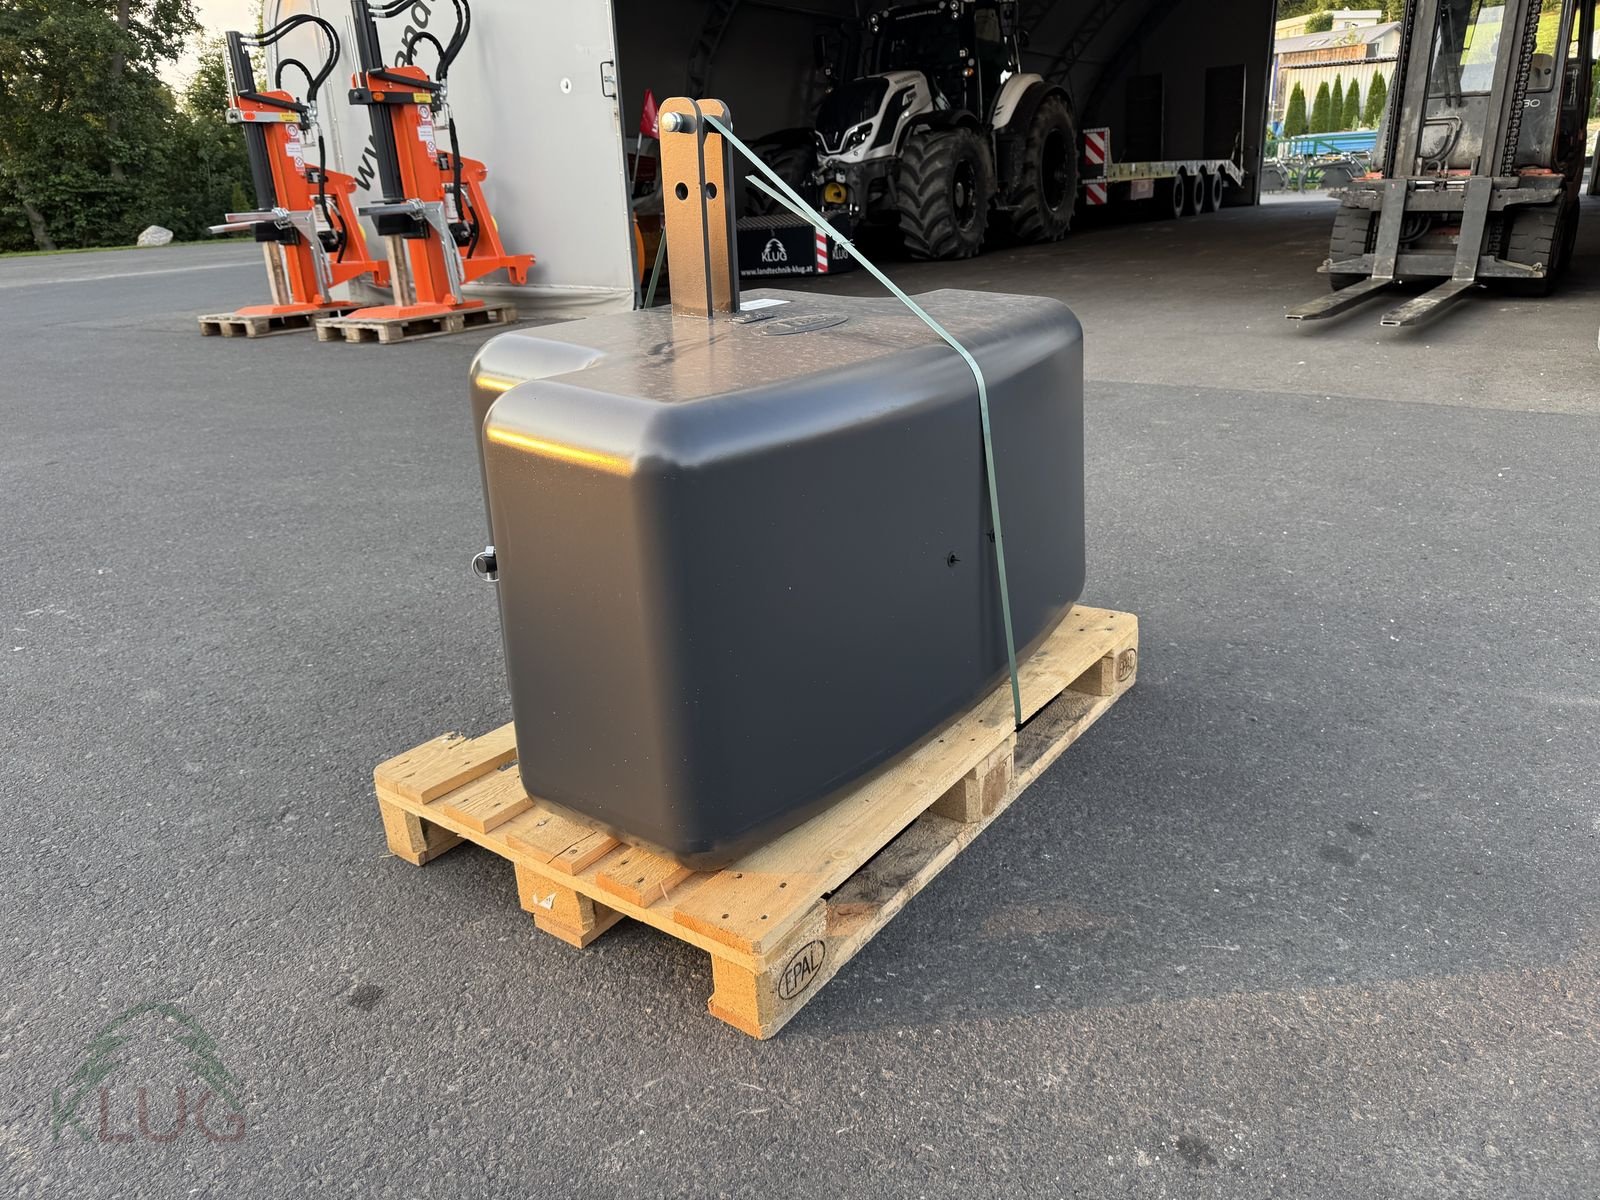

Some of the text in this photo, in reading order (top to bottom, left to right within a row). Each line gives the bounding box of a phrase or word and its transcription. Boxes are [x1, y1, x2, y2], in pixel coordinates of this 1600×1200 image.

[761, 250, 788, 262] KLUG
[740, 265, 814, 276] www.landtechnik-klug.at
[785, 944, 819, 996] EPAL
